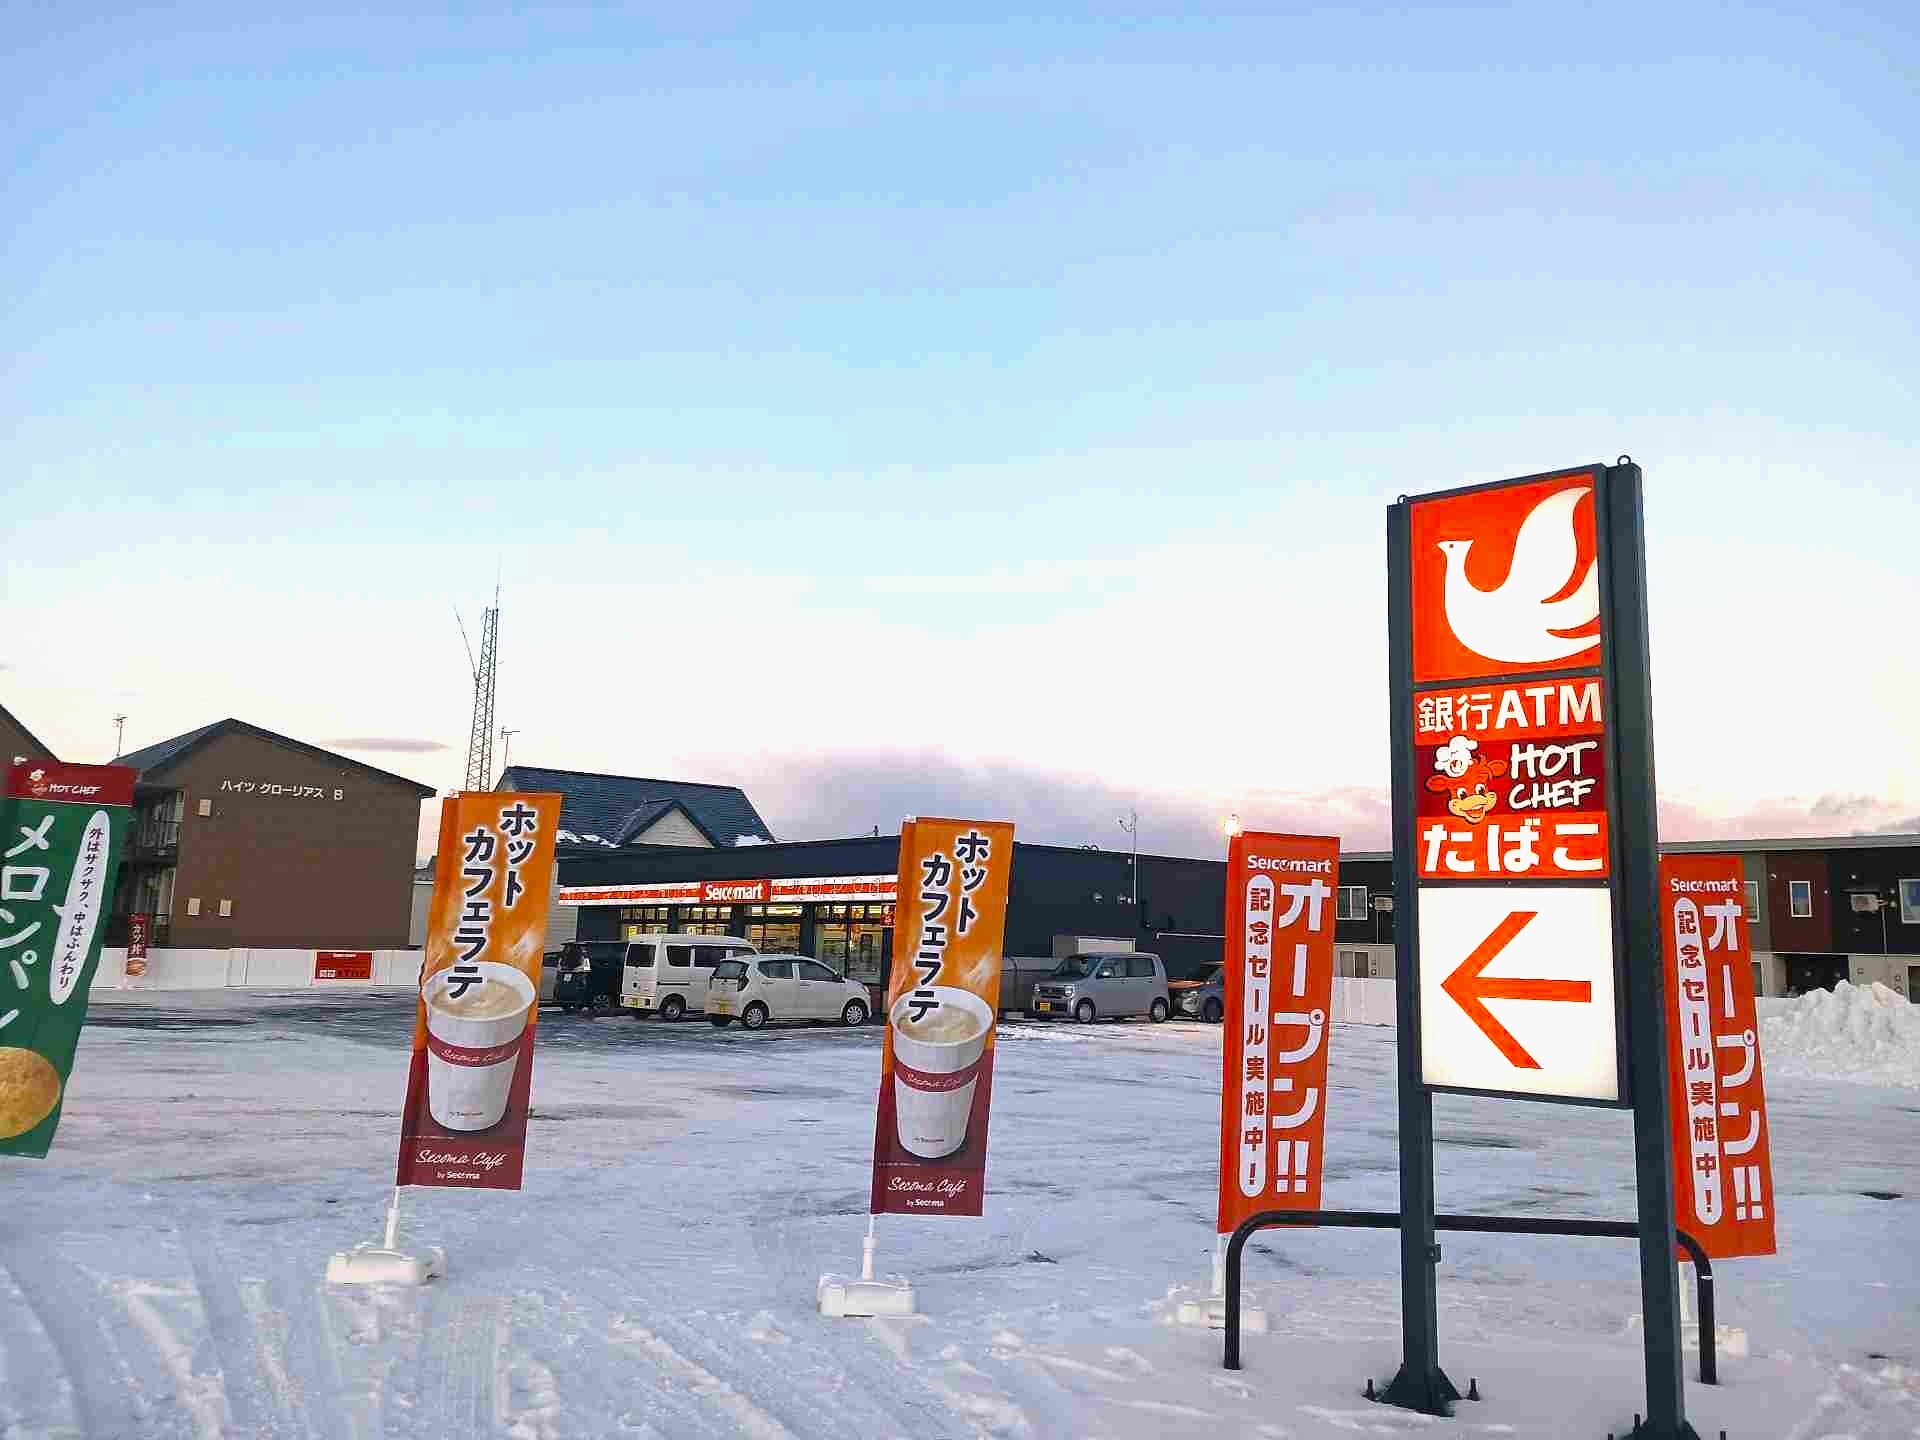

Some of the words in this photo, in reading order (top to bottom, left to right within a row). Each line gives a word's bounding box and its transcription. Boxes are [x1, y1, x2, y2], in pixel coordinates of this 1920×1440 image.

[1418, 683, 1603, 733] 銀行ATM
[1509, 740, 1598, 779] HOT
[220, 779, 256, 793] ハイツ
[260, 782, 325, 799] グローリアス
[1508, 778, 1596, 809] CHEF
[499, 803, 537, 907] ホット
[1247, 855, 1332, 874] Seicomart
[1423, 818, 1604, 873] たばこ
[59, 827, 104, 989] 外はサクサク、中はふんわり
[703, 881, 764, 900] Seicomart
[956, 831, 989, 933] ホット
[1671, 878, 1738, 892] Seicomart
[0, 814, 55, 1029] メロンパ
[446, 828, 497, 999] カフェラテ
[909, 854, 951, 1023] カフェラテ
